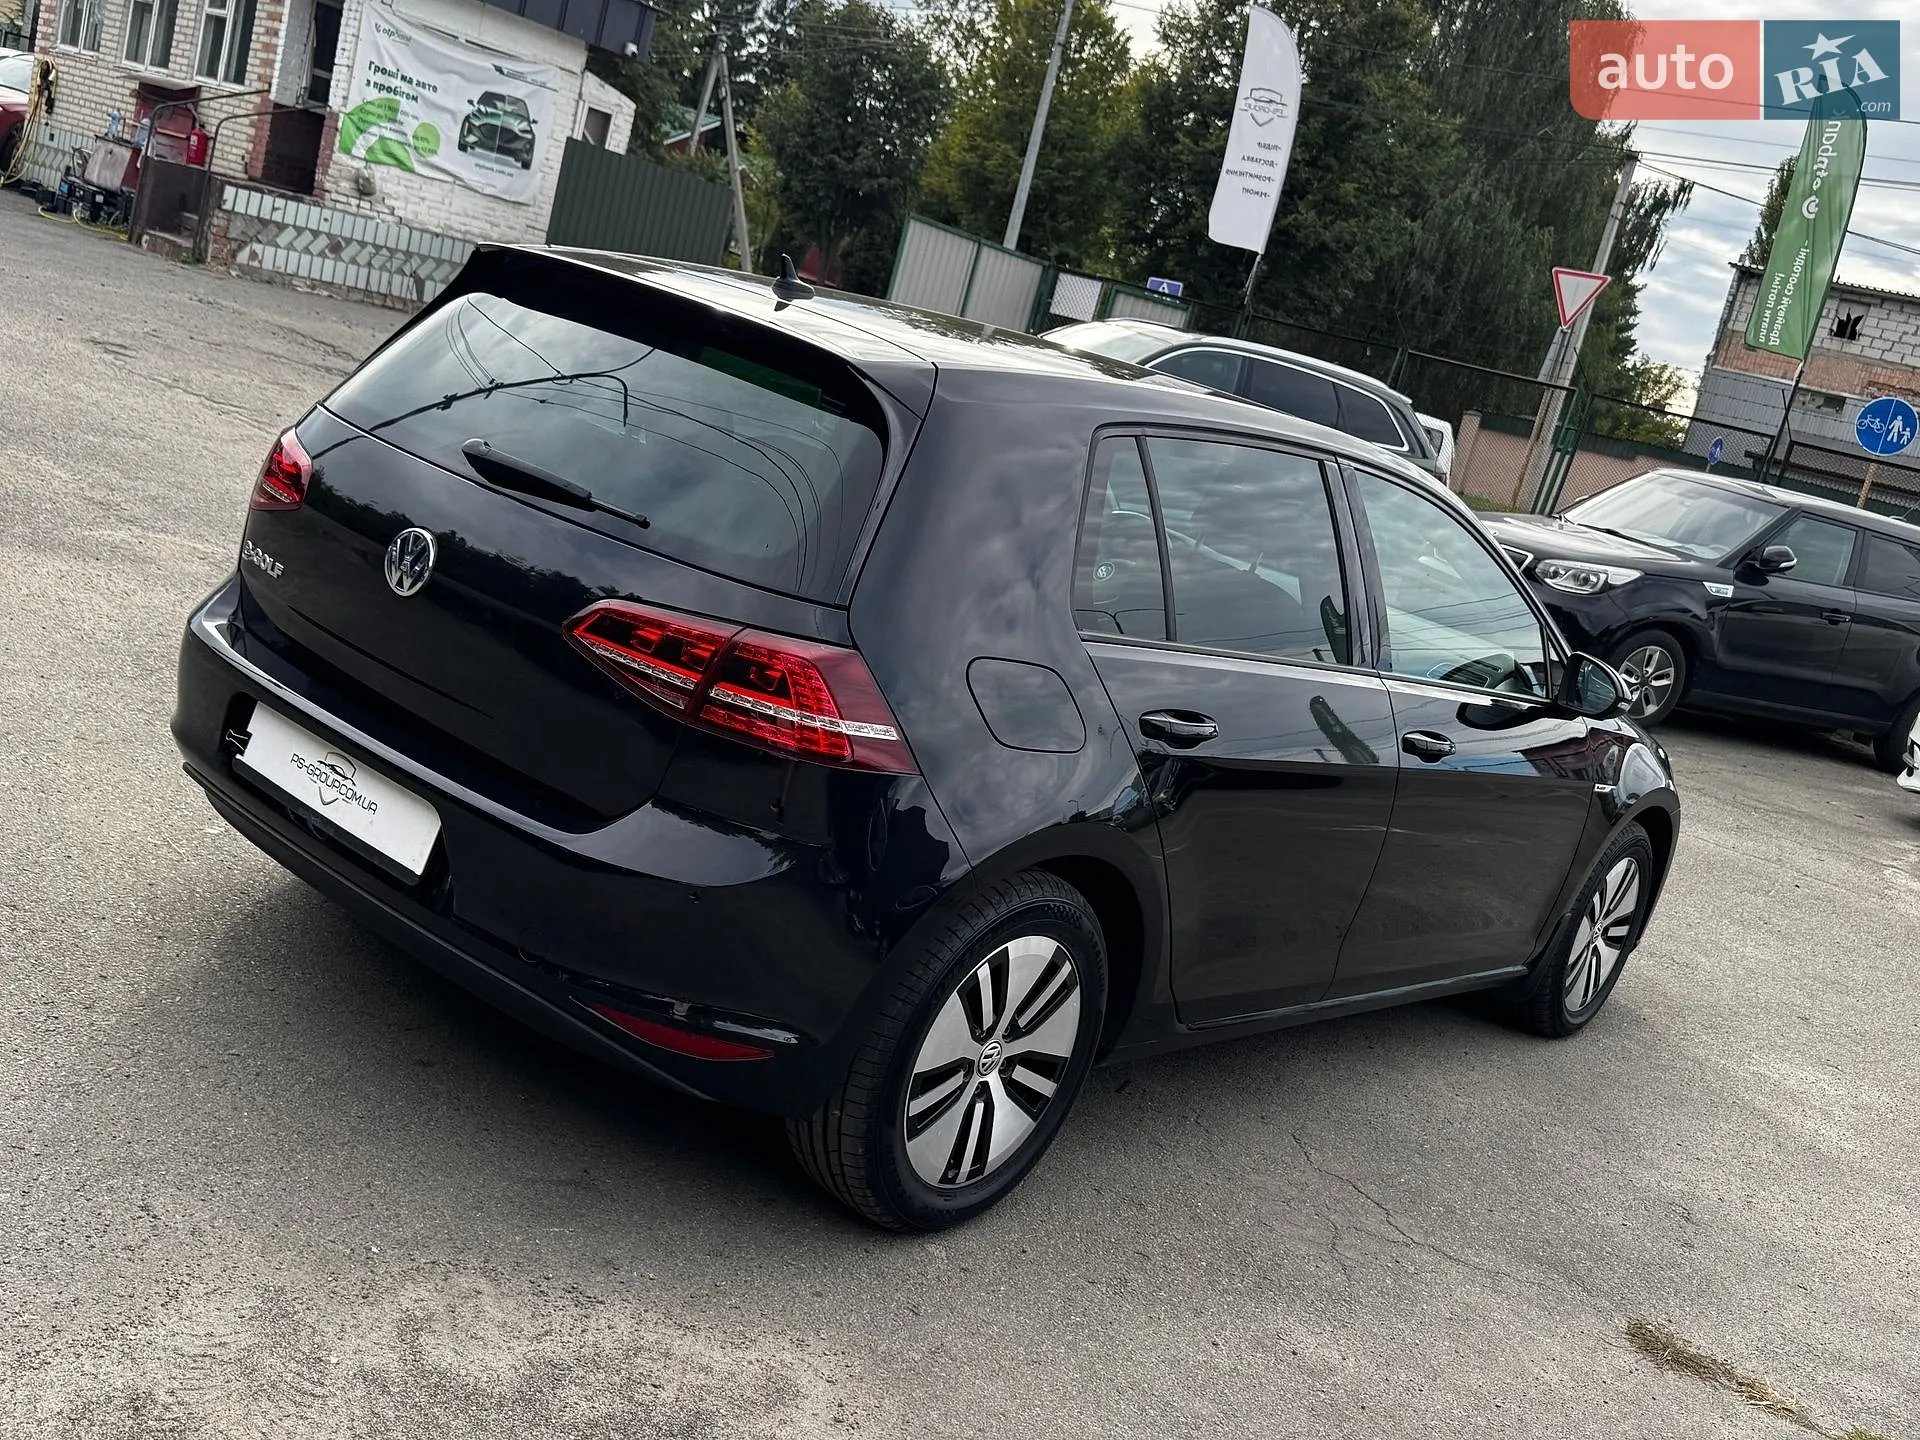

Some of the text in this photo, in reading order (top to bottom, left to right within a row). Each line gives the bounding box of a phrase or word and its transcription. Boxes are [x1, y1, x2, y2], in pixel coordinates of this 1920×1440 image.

[365, 78, 419, 104] з пробігом
[368, 60, 438, 94] Гроші на авто
[290, 753, 378, 816] PS-GROUP.COM.UA
